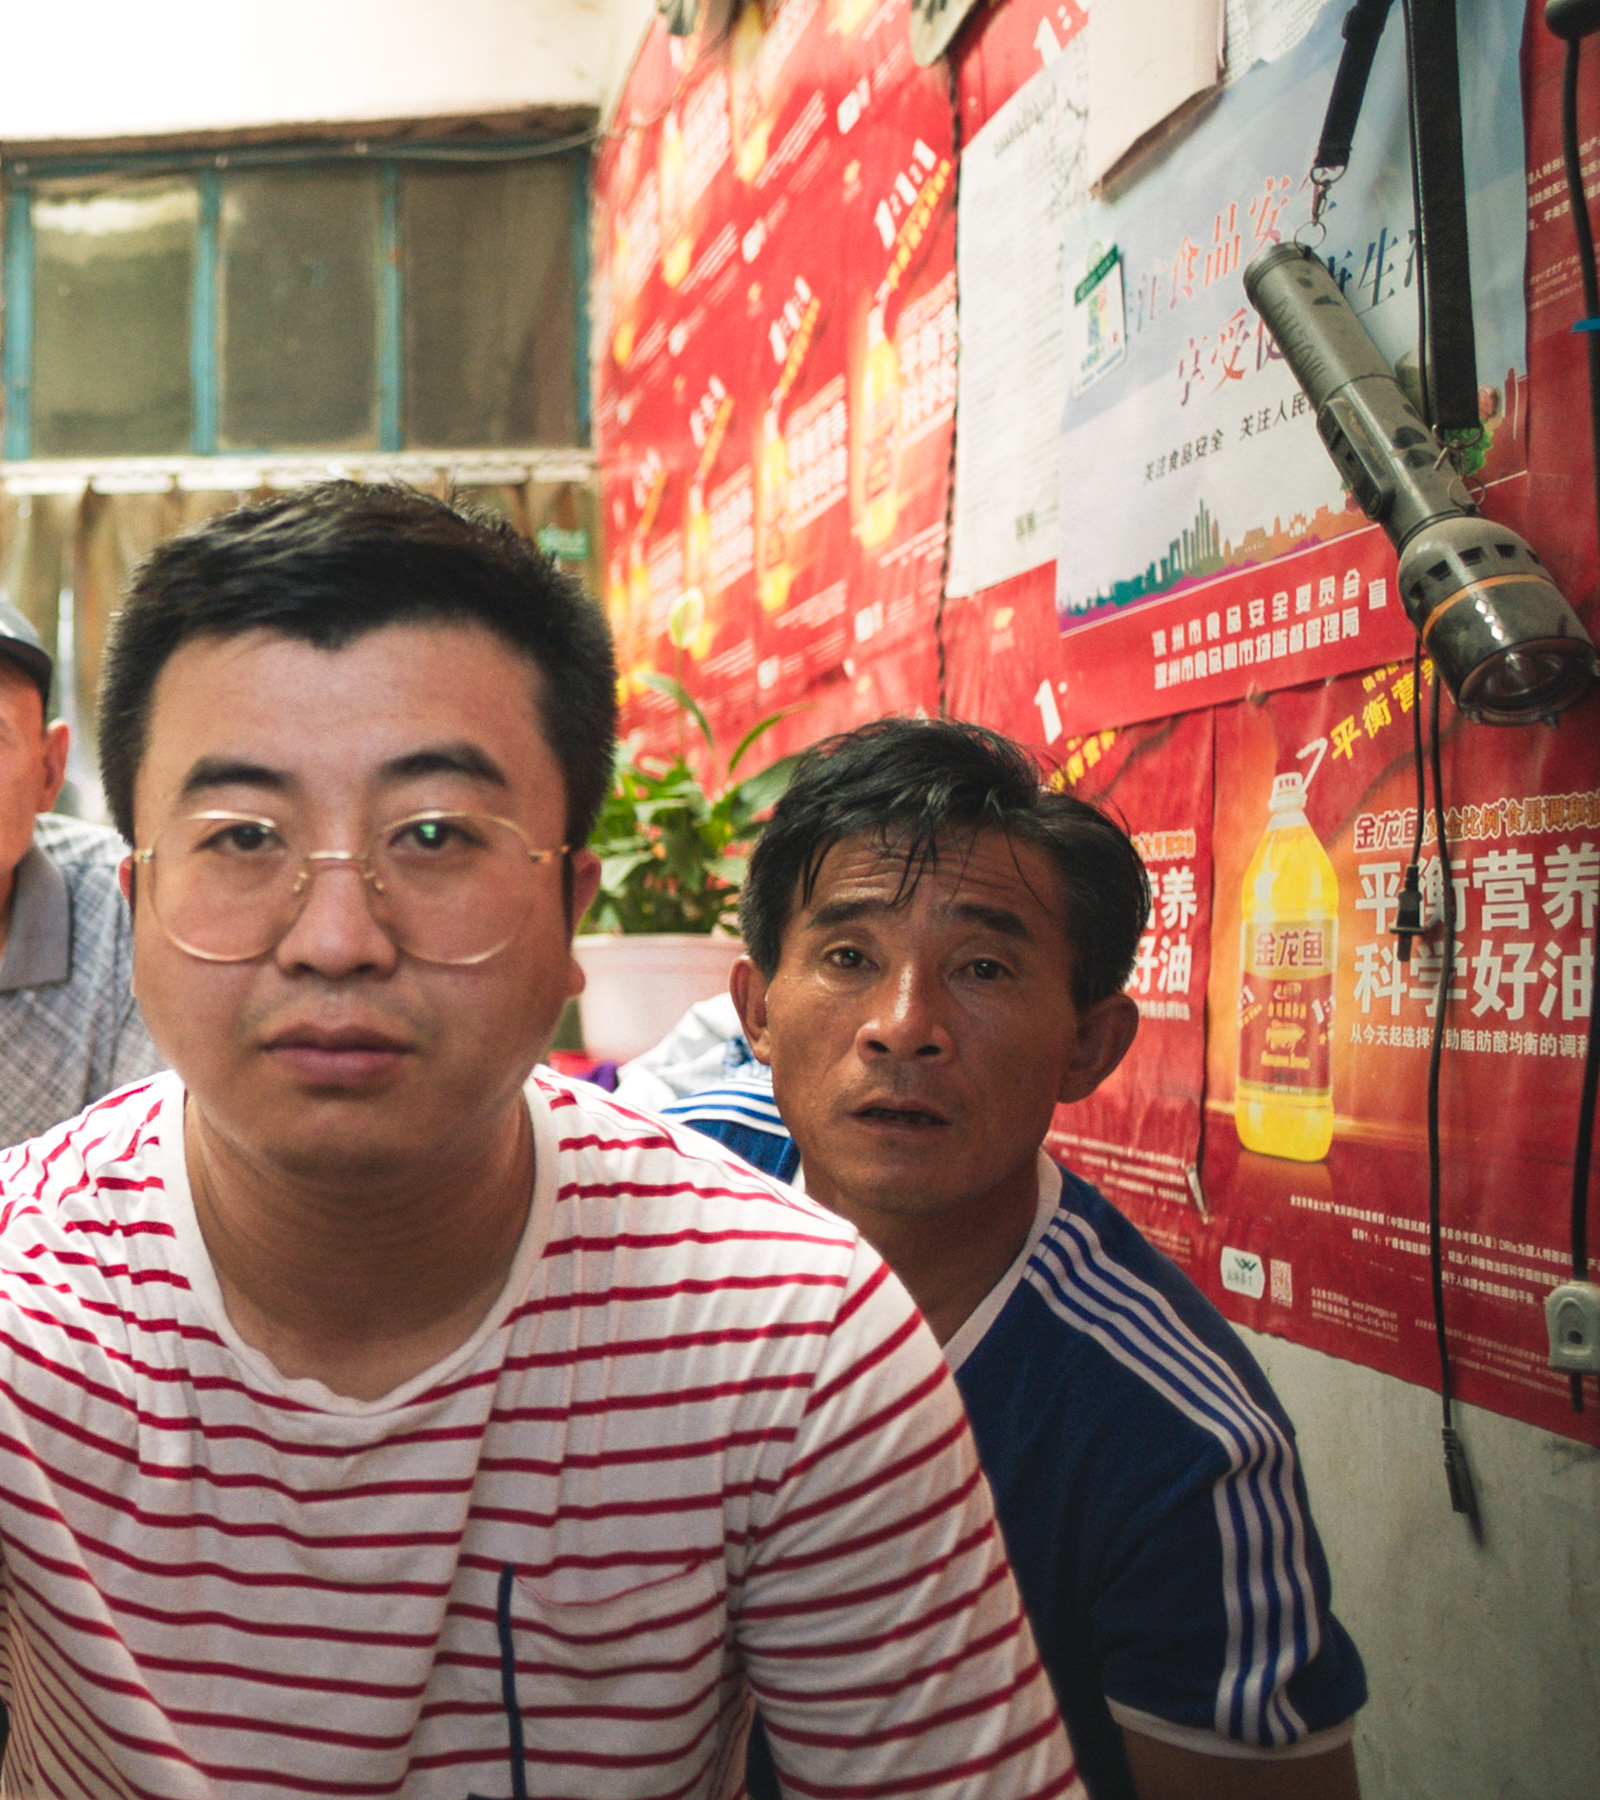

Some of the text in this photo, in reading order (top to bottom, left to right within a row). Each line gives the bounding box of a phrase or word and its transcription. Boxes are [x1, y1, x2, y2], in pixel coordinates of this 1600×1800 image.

[1144, 391, 1314, 485] 关注食品安全 关注人民
[1145, 866, 1198, 931] 养
[1355, 842, 1600, 935] 平衡营养
[1255, 929, 1325, 967] 金龙鱼
[1352, 937, 1599, 1021] 科学好油
[1350, 1023, 1589, 1059] 从今天起选择助脂肪酸均衡的调
